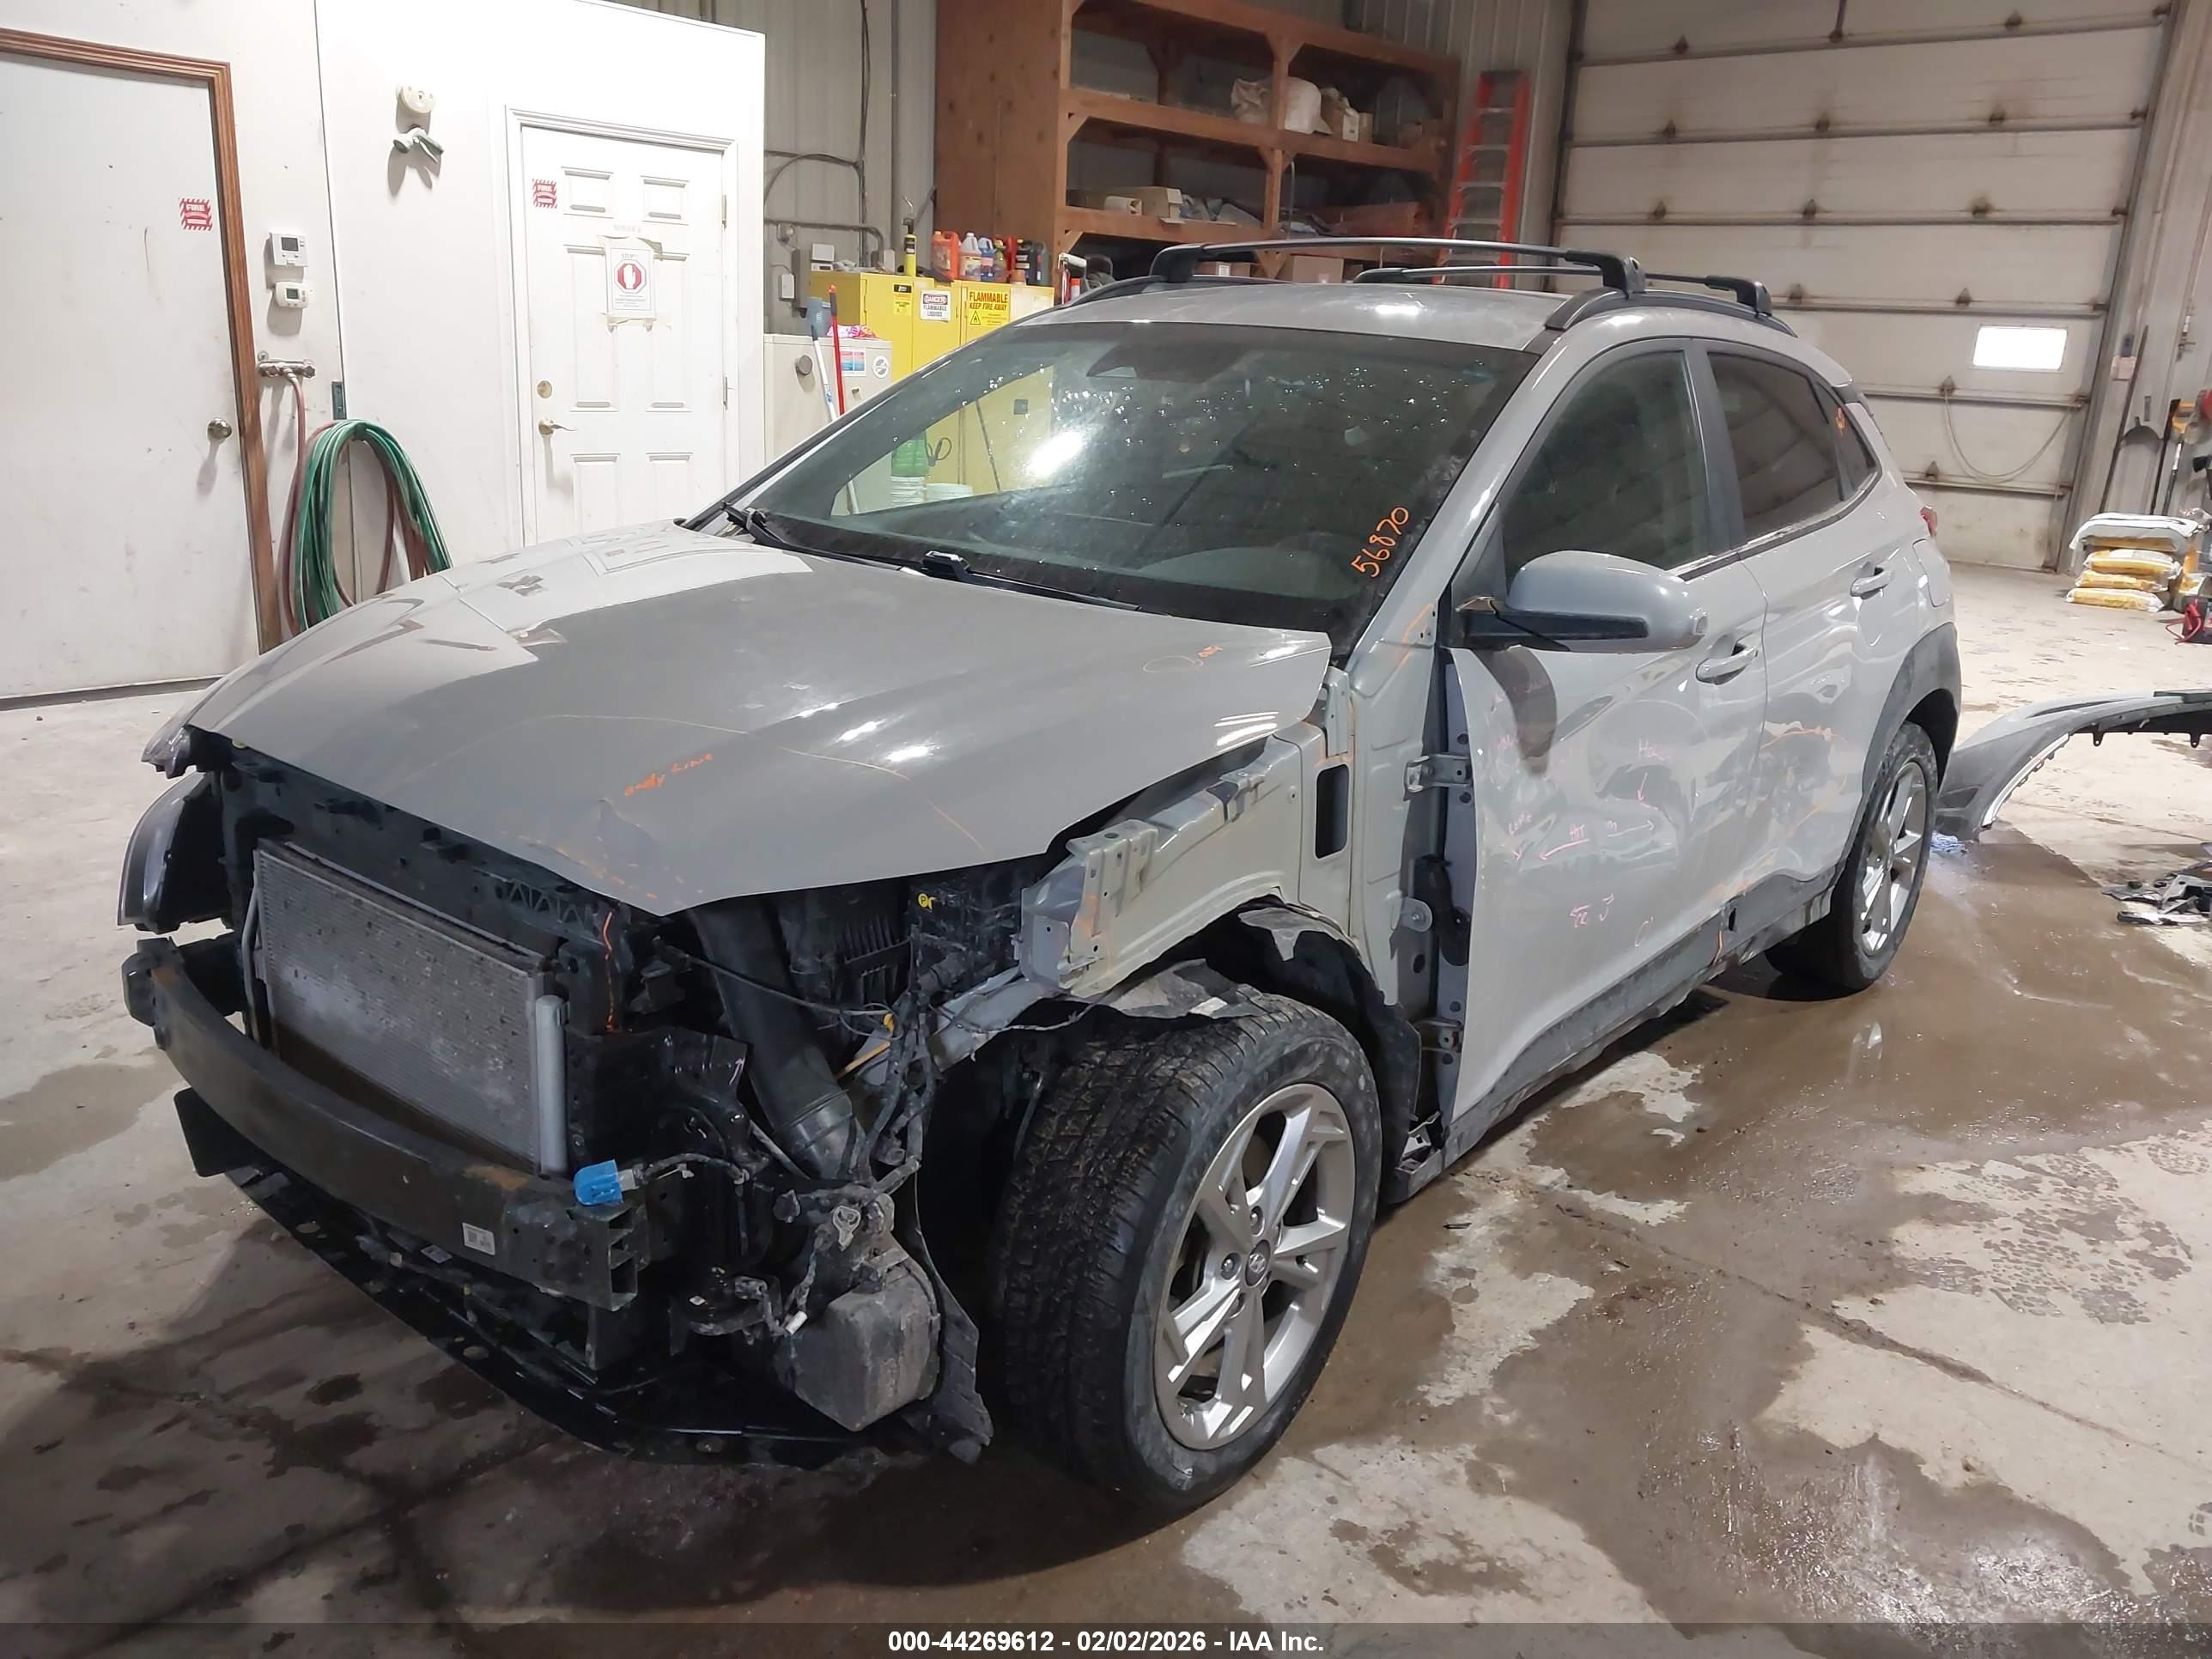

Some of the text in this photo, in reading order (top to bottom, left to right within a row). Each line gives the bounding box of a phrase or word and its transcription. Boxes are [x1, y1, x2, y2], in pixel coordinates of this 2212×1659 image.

[185, 204, 205, 212] FIRE
[924, 295, 947, 303] DANGER
[969, 291, 1008, 303] FLAMMABLE
[1351, 507, 1409, 578] 56870
